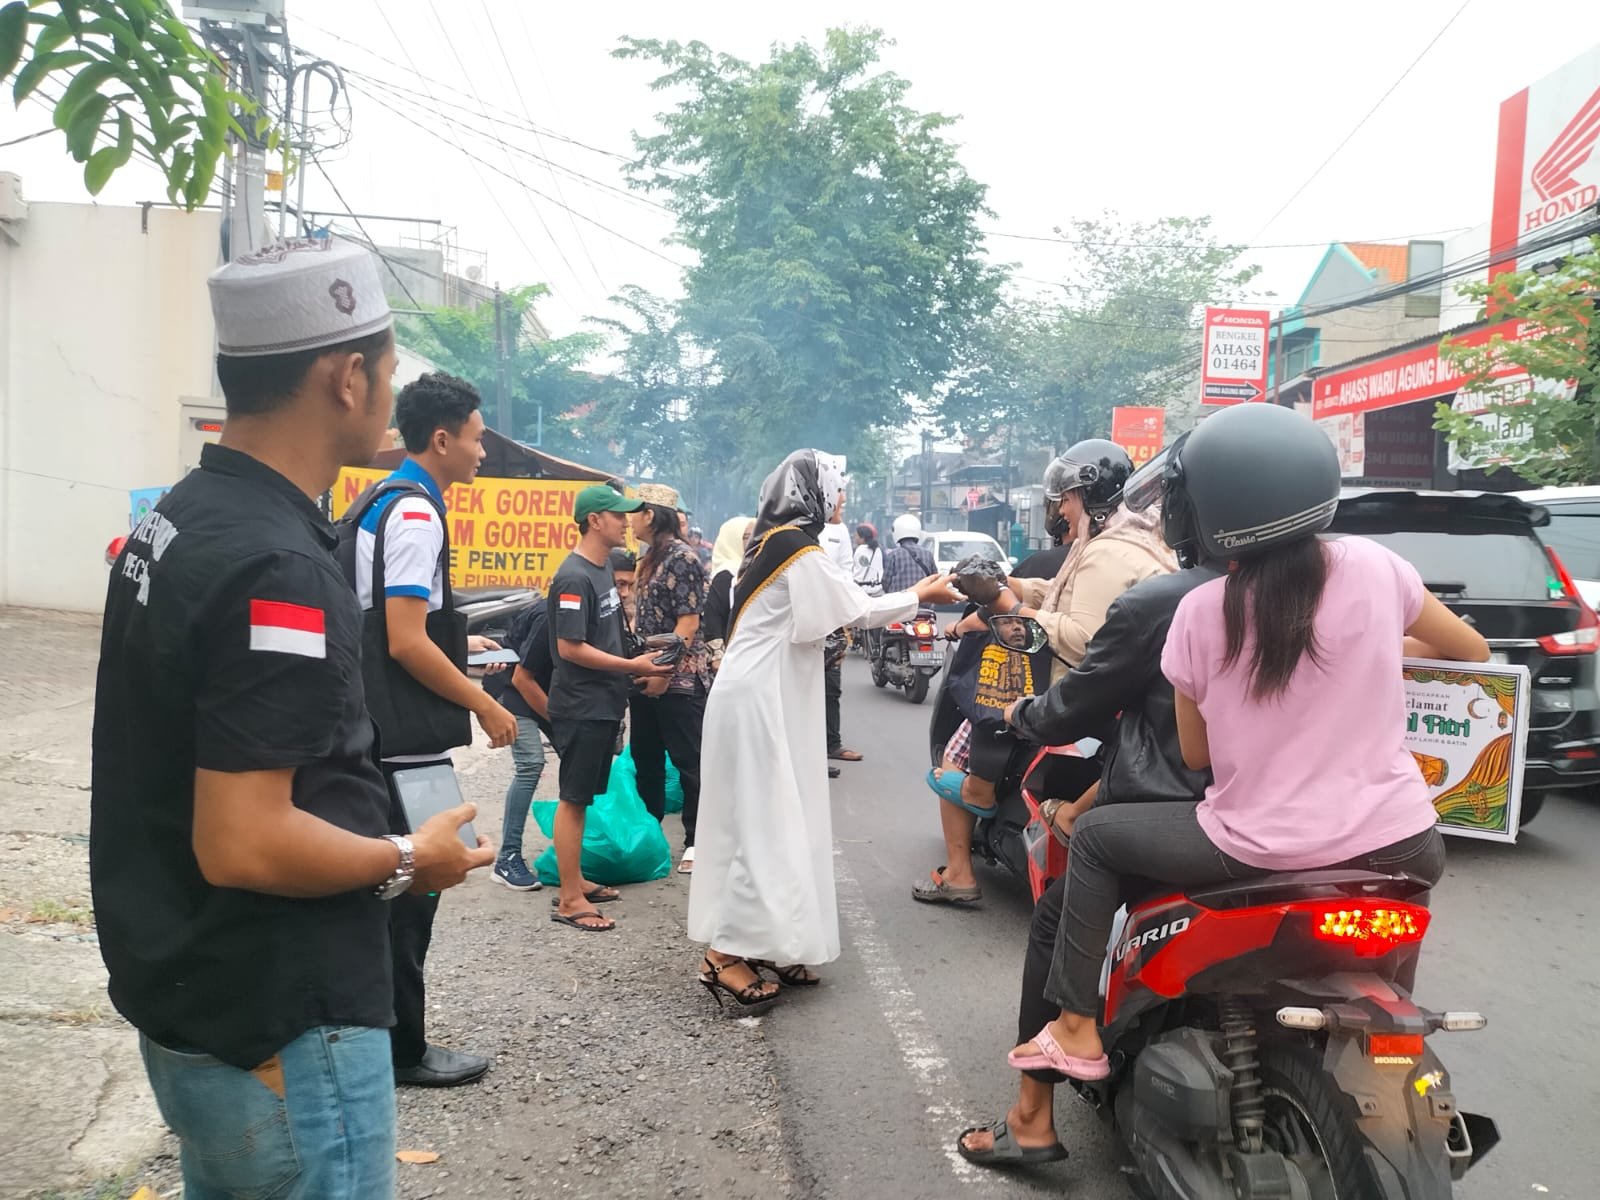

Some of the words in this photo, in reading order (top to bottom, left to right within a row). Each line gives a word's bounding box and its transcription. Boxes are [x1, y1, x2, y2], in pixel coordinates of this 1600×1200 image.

[1223, 316, 1263, 325] HONDA
[1215, 331, 1257, 341] BENGKEL
[1211, 343, 1261, 357] AHASS
[1213, 357, 1257, 371] 01464
[1339, 378, 1369, 407] AHASS
[1368, 370, 1397, 400] WARU
[1397, 358, 1435, 392] AGUNG
[496, 489, 575, 518] GOREN
[485, 520, 579, 551] GORENG
[1218, 535, 1256, 549] Classic
[469, 550, 549, 571] PENYET
[1422, 714, 1470, 738] Fitri
[1116, 917, 1190, 962] VARIO
[1374, 1056, 1414, 1065] HONDA
